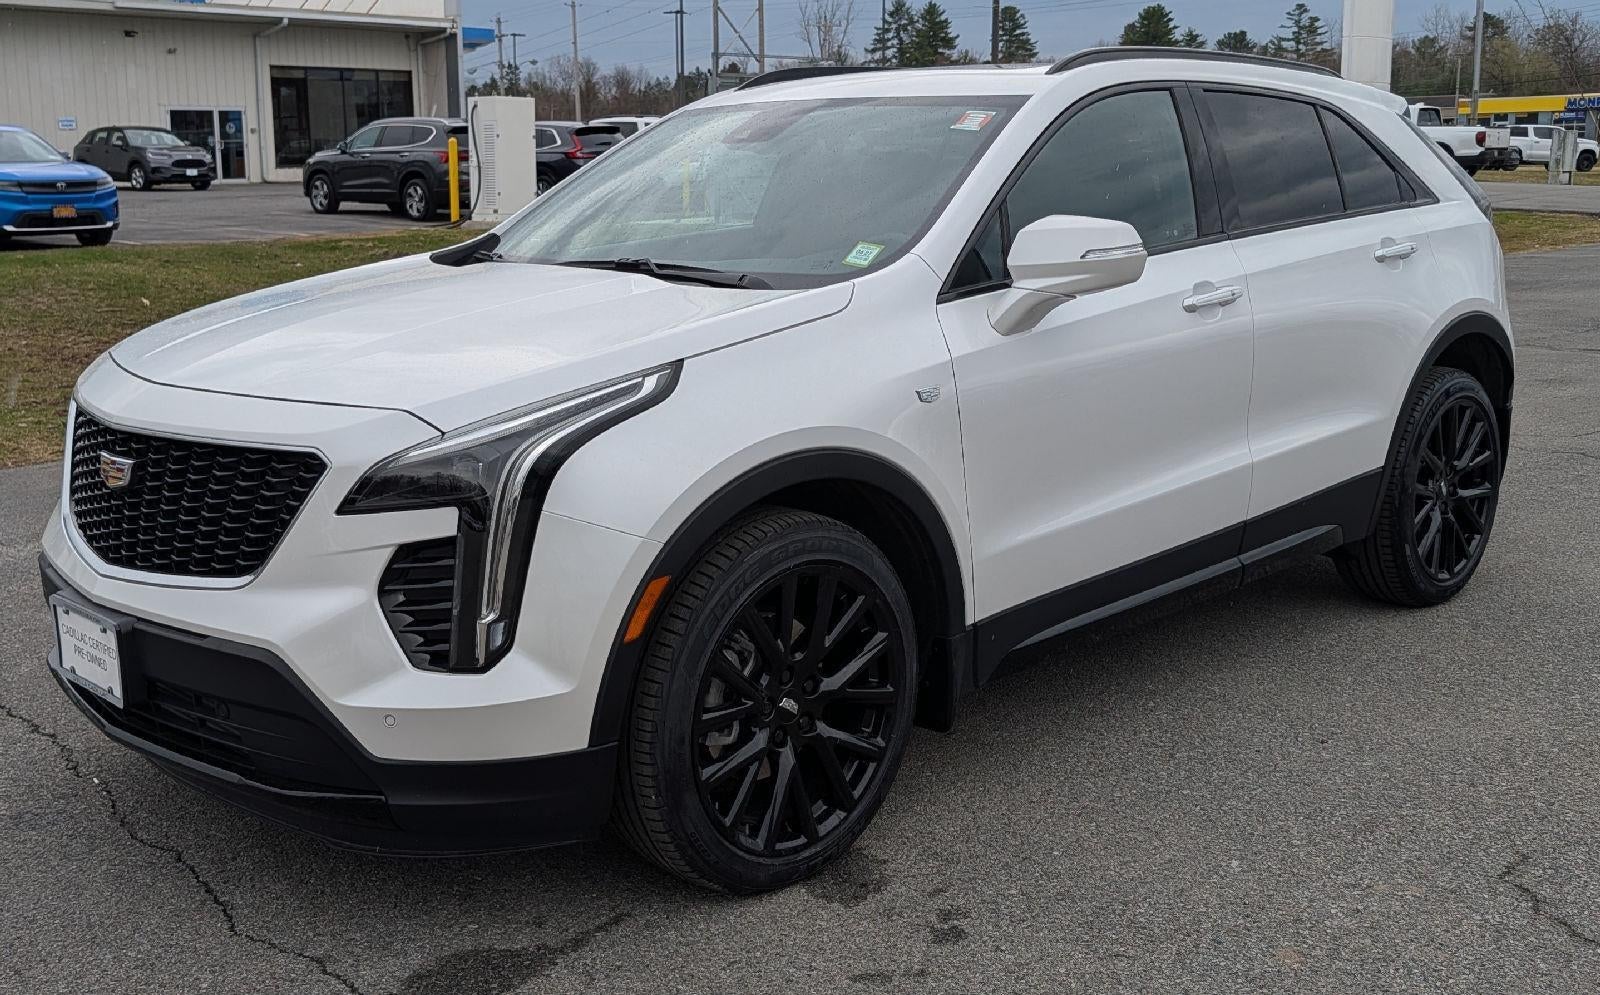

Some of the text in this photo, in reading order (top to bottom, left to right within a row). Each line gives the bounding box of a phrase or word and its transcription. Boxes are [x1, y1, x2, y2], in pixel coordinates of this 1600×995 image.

[62, 623, 116, 660] CADILLAC CERTIFIED
[73, 643, 107, 671] PRE-OWNED
